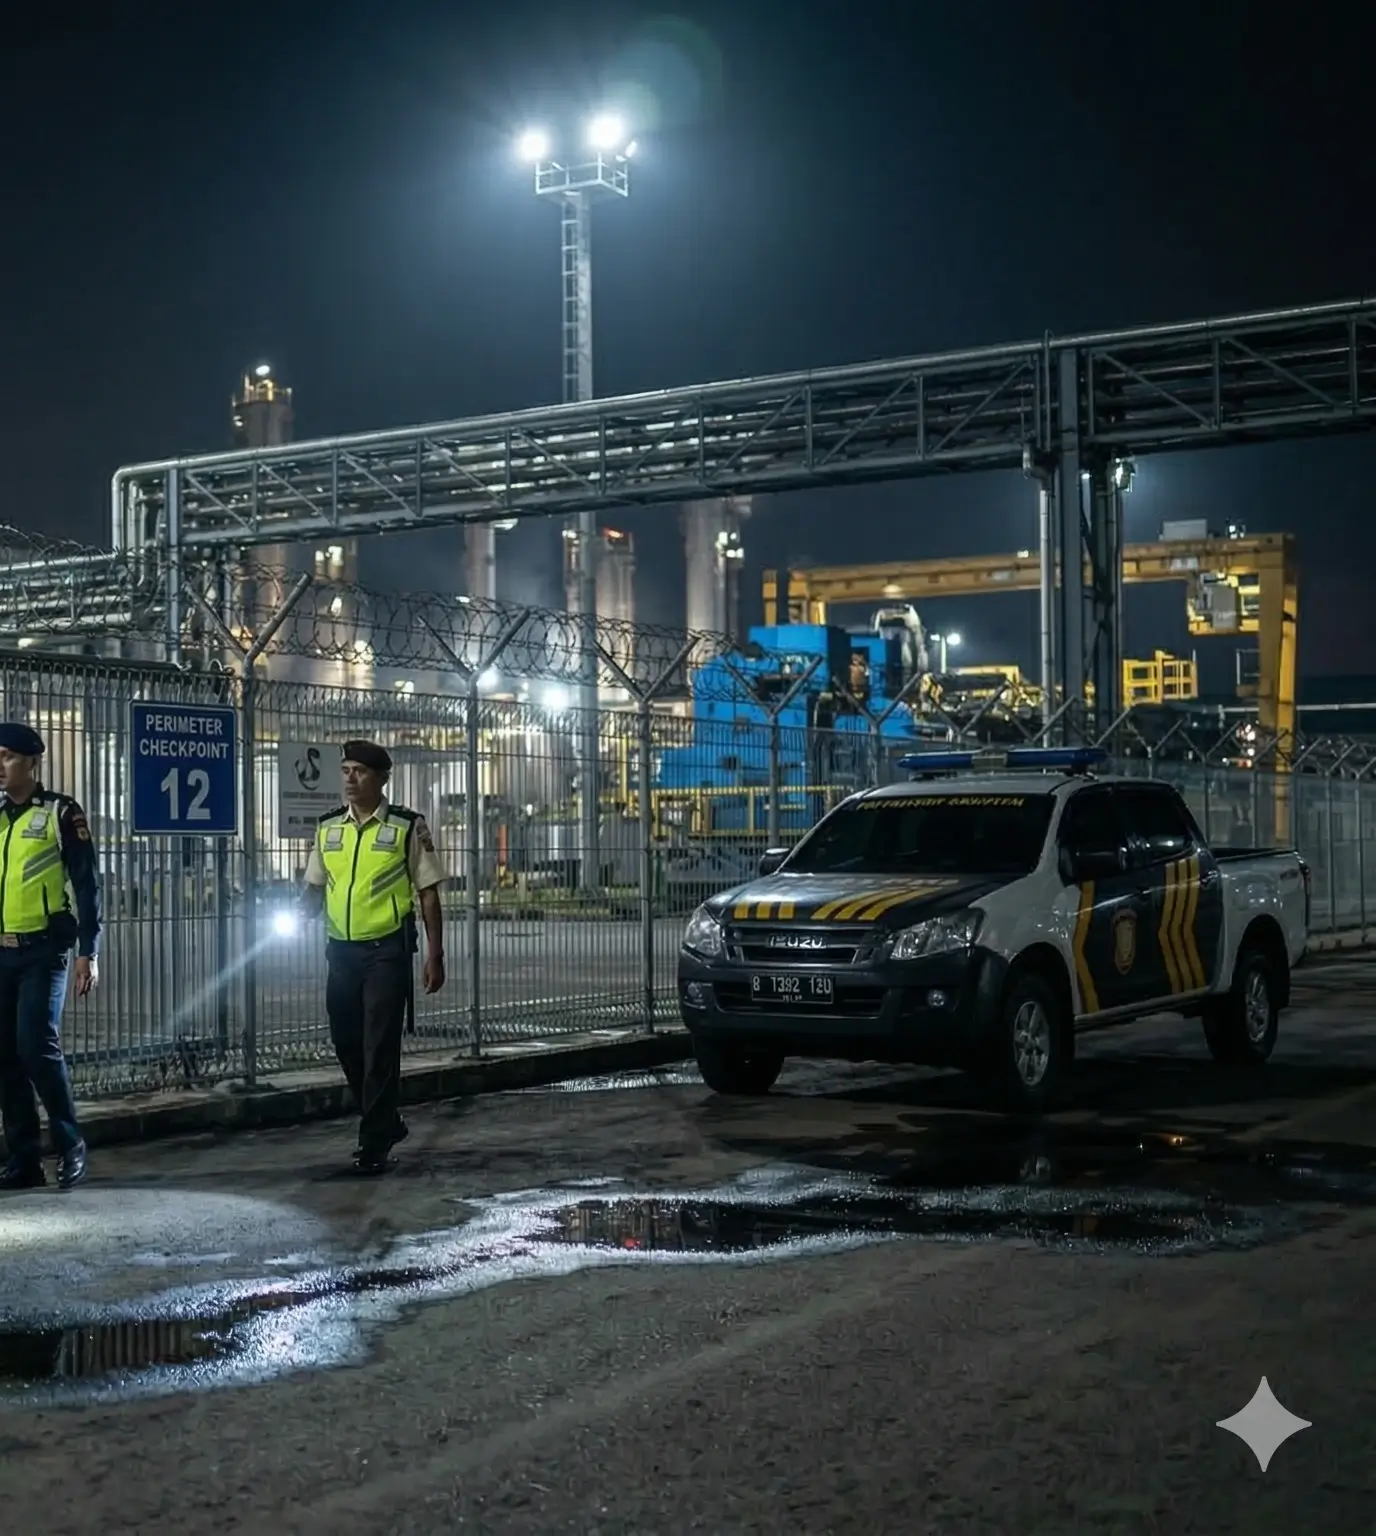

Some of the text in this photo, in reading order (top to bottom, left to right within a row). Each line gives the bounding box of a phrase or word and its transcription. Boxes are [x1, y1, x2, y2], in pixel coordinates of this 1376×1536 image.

[146, 714, 223, 735] PERIMETER
[139, 738, 229, 759] CHECKPOINT
[160, 767, 211, 820] 12
